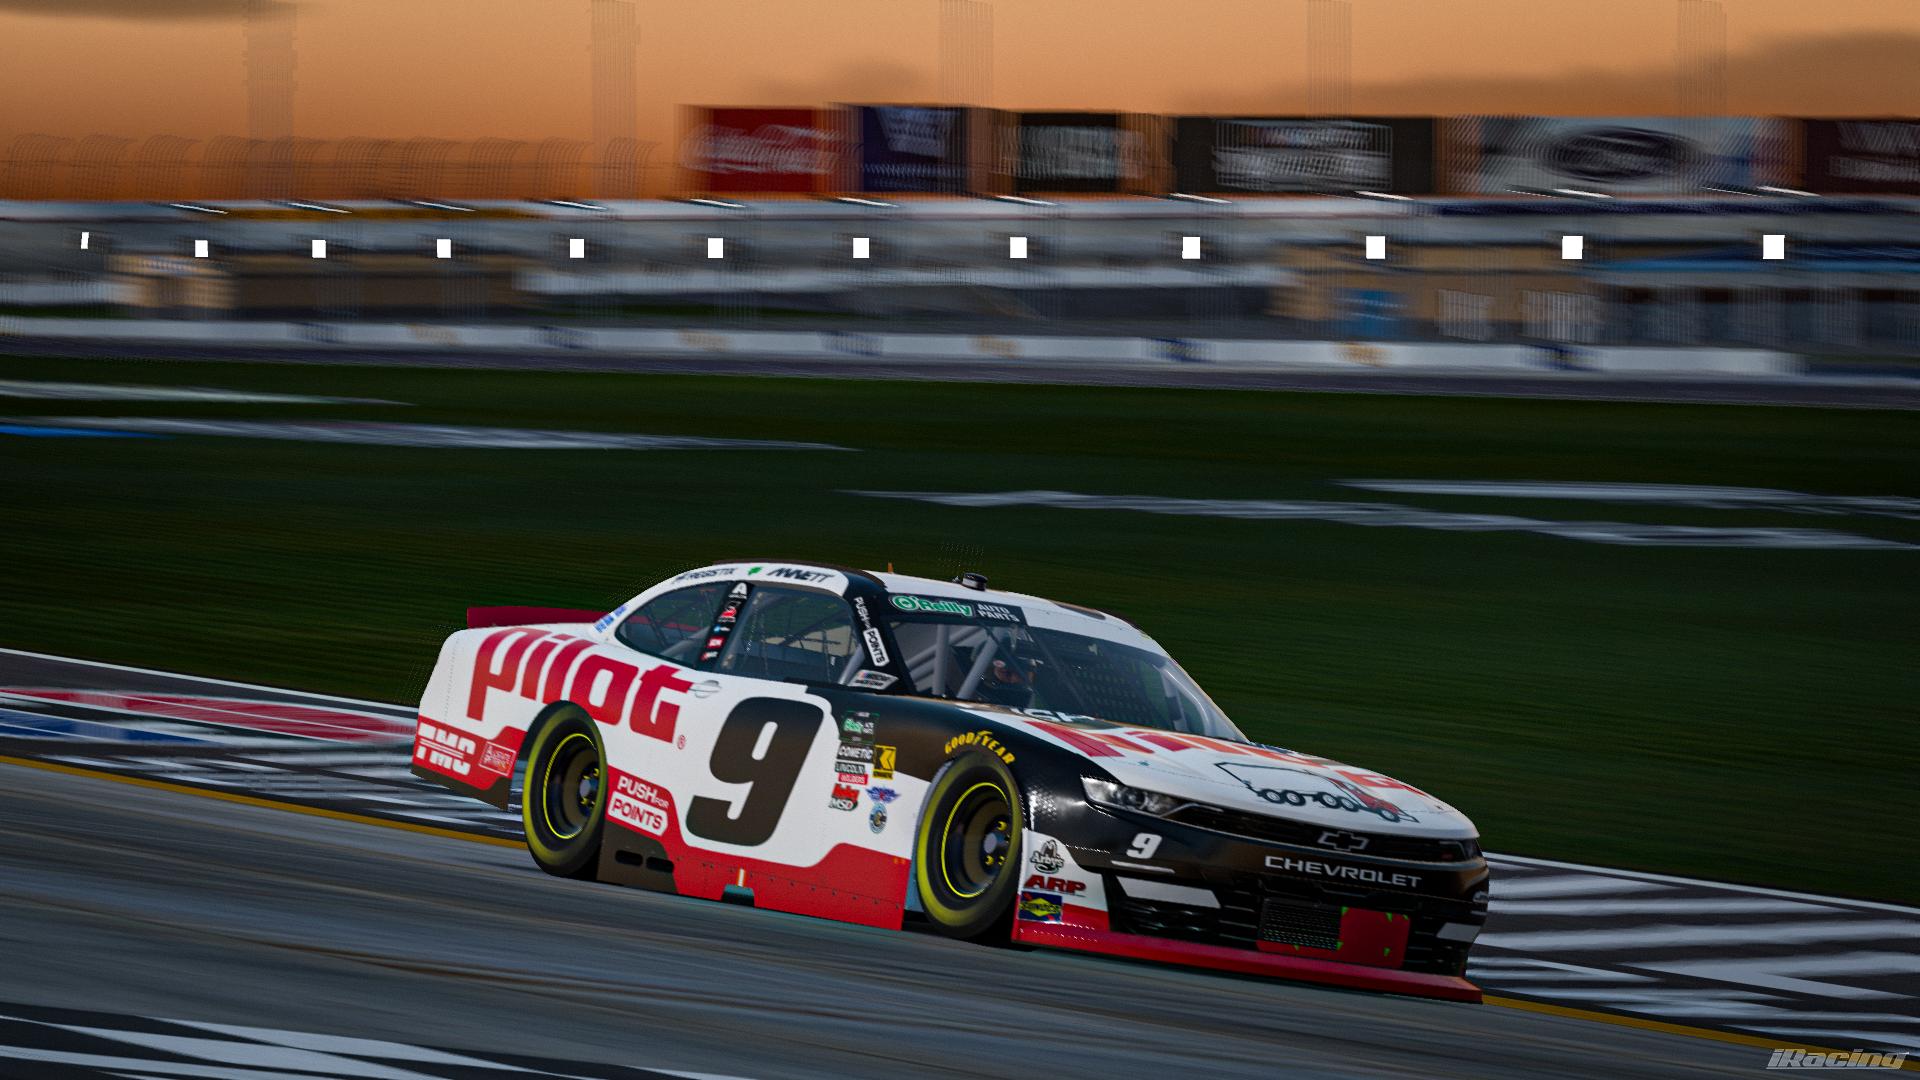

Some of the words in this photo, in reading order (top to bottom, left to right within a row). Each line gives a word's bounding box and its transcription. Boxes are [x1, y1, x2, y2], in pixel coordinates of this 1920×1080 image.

[854, 596, 870, 621] PUSH
[977, 603, 1010, 615] AUTO
[979, 610, 1020, 622] PARTS
[466, 627, 694, 744] pilot
[944, 730, 1015, 765] GOODYEAR
[685, 696, 825, 847] 9
[617, 776, 657, 802] PUSH
[611, 798, 663, 830] POINTS
[1125, 832, 1162, 859] 9
[1024, 874, 1087, 894] ARP
[1264, 855, 1422, 888] CHEVROLET
